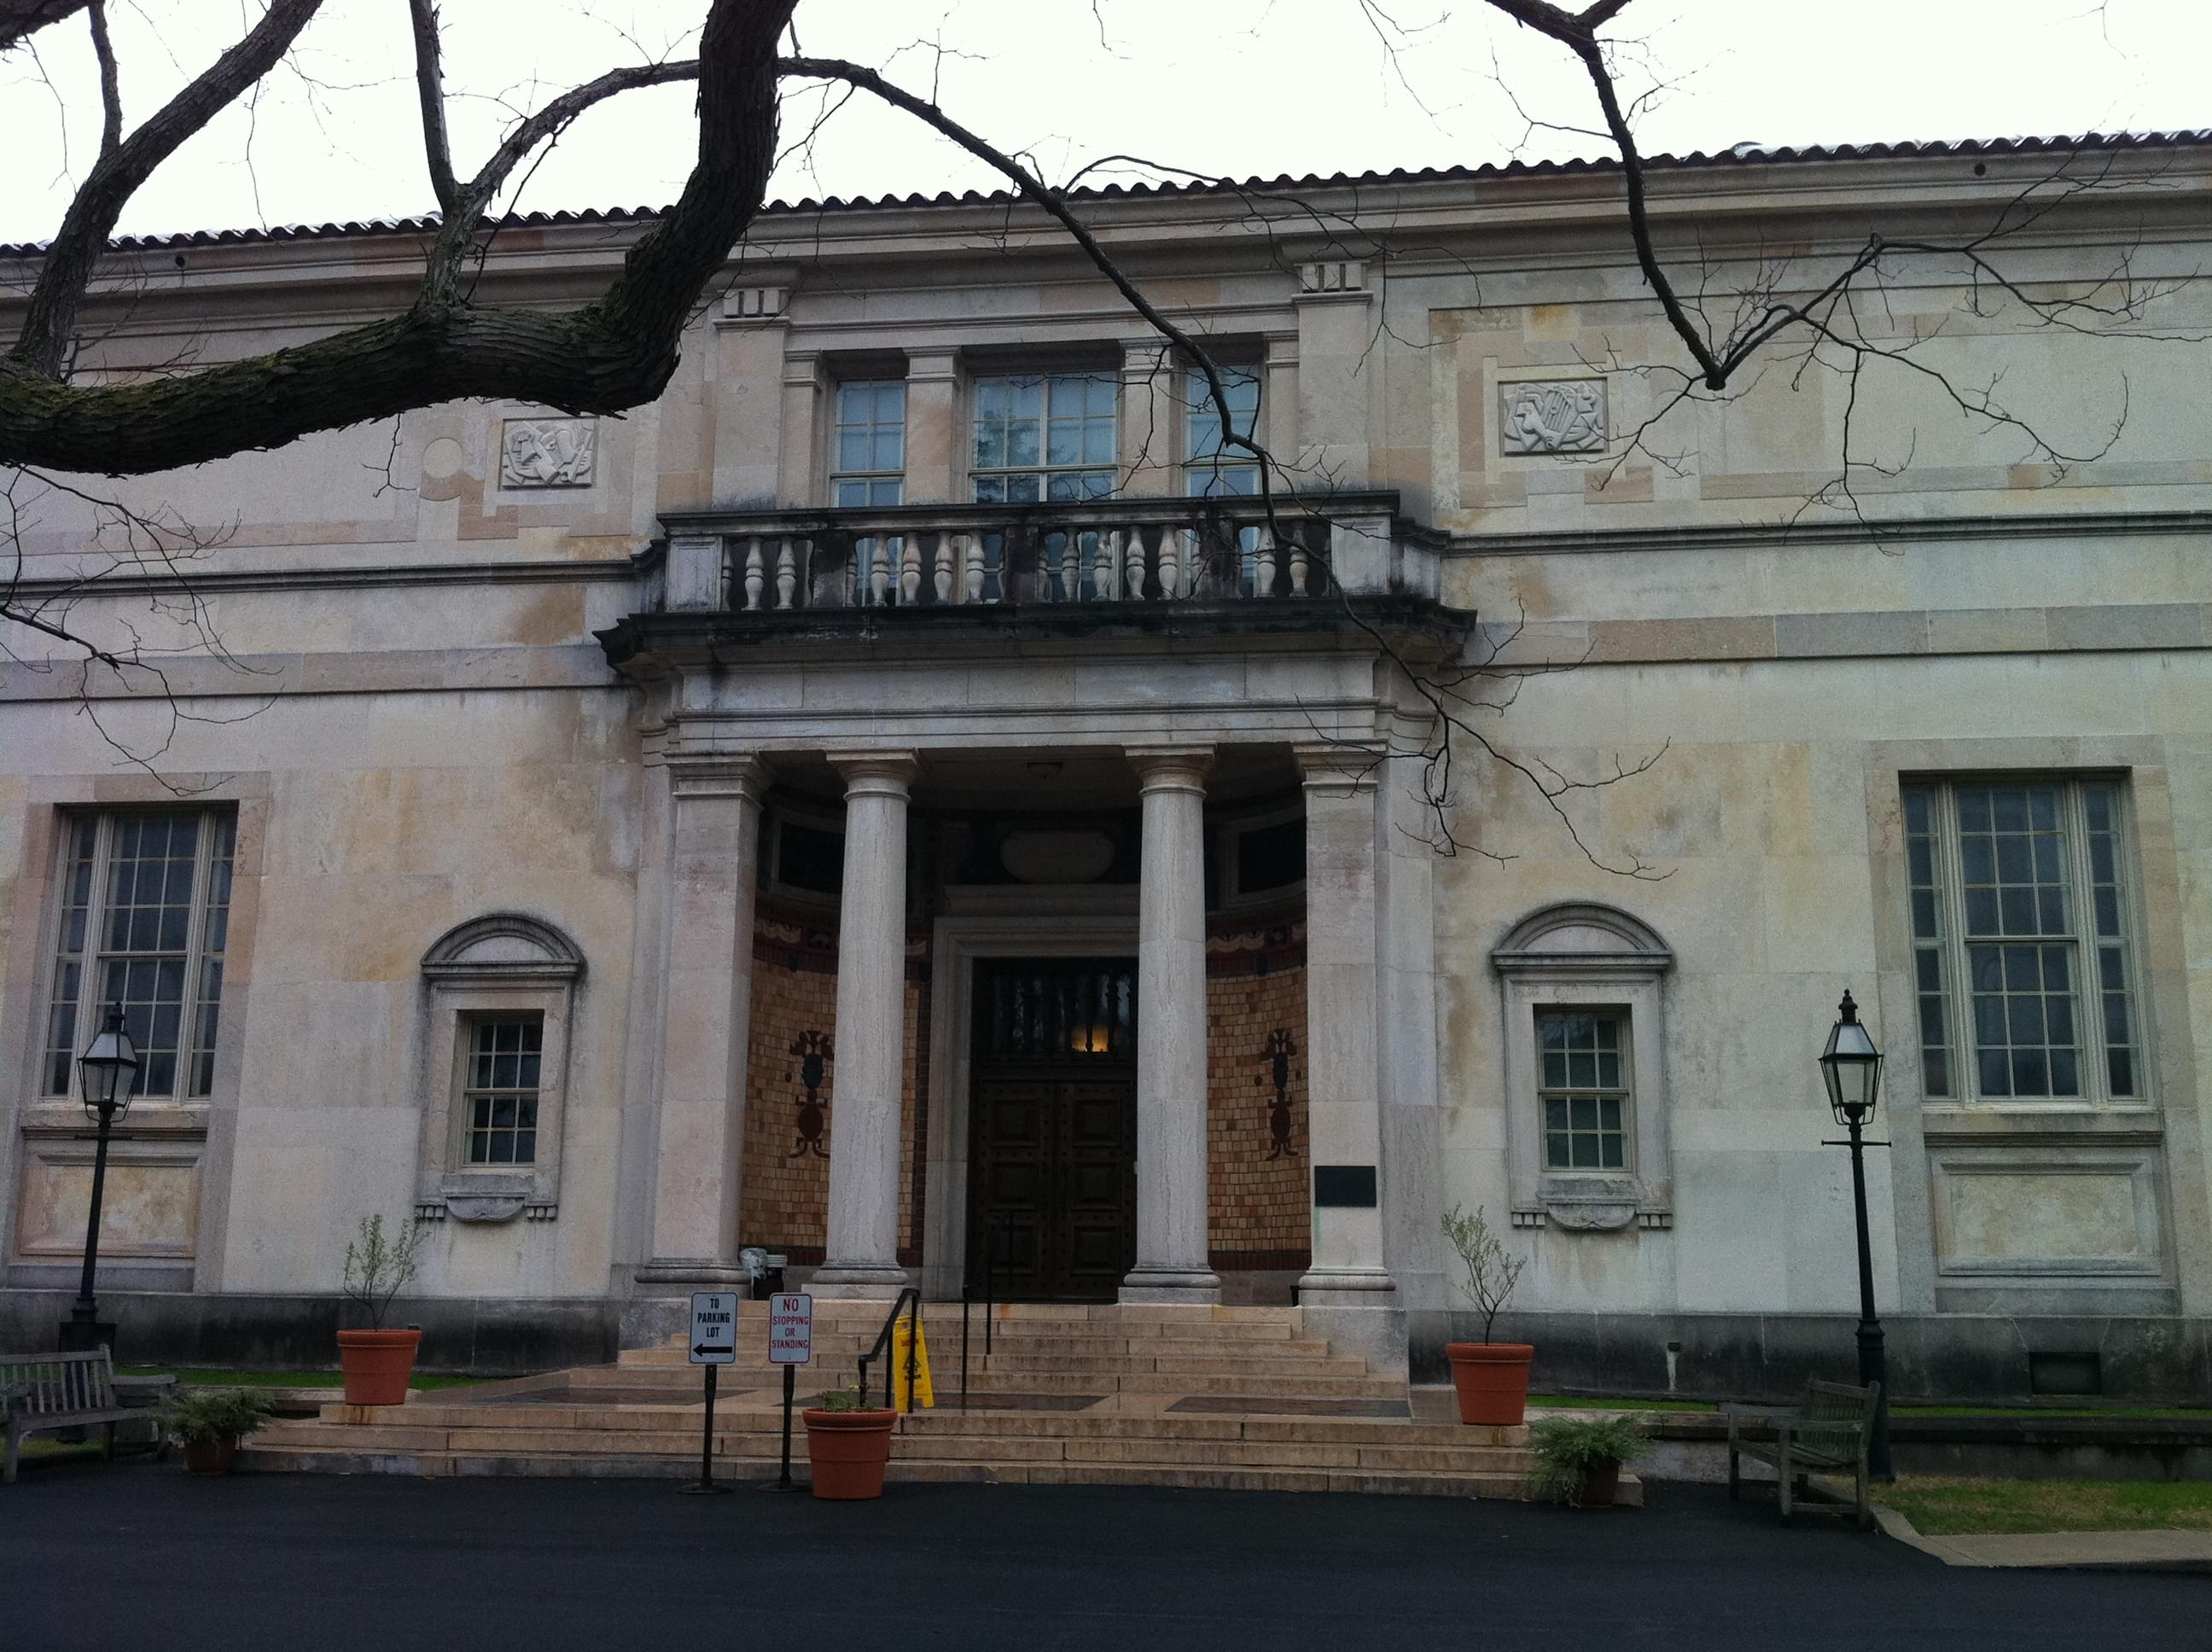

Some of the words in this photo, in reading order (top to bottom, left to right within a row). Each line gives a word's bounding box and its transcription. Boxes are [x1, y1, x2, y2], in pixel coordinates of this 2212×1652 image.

[710, 1298, 719, 1309] TO
[783, 1299, 799, 1312] NO
[697, 1312, 731, 1323] PARKING
[772, 1316, 809, 1325] STOPPING
[706, 1327, 720, 1338] LOT
[784, 1328, 795, 1337] OR
[771, 1340, 808, 1349] STANDING
